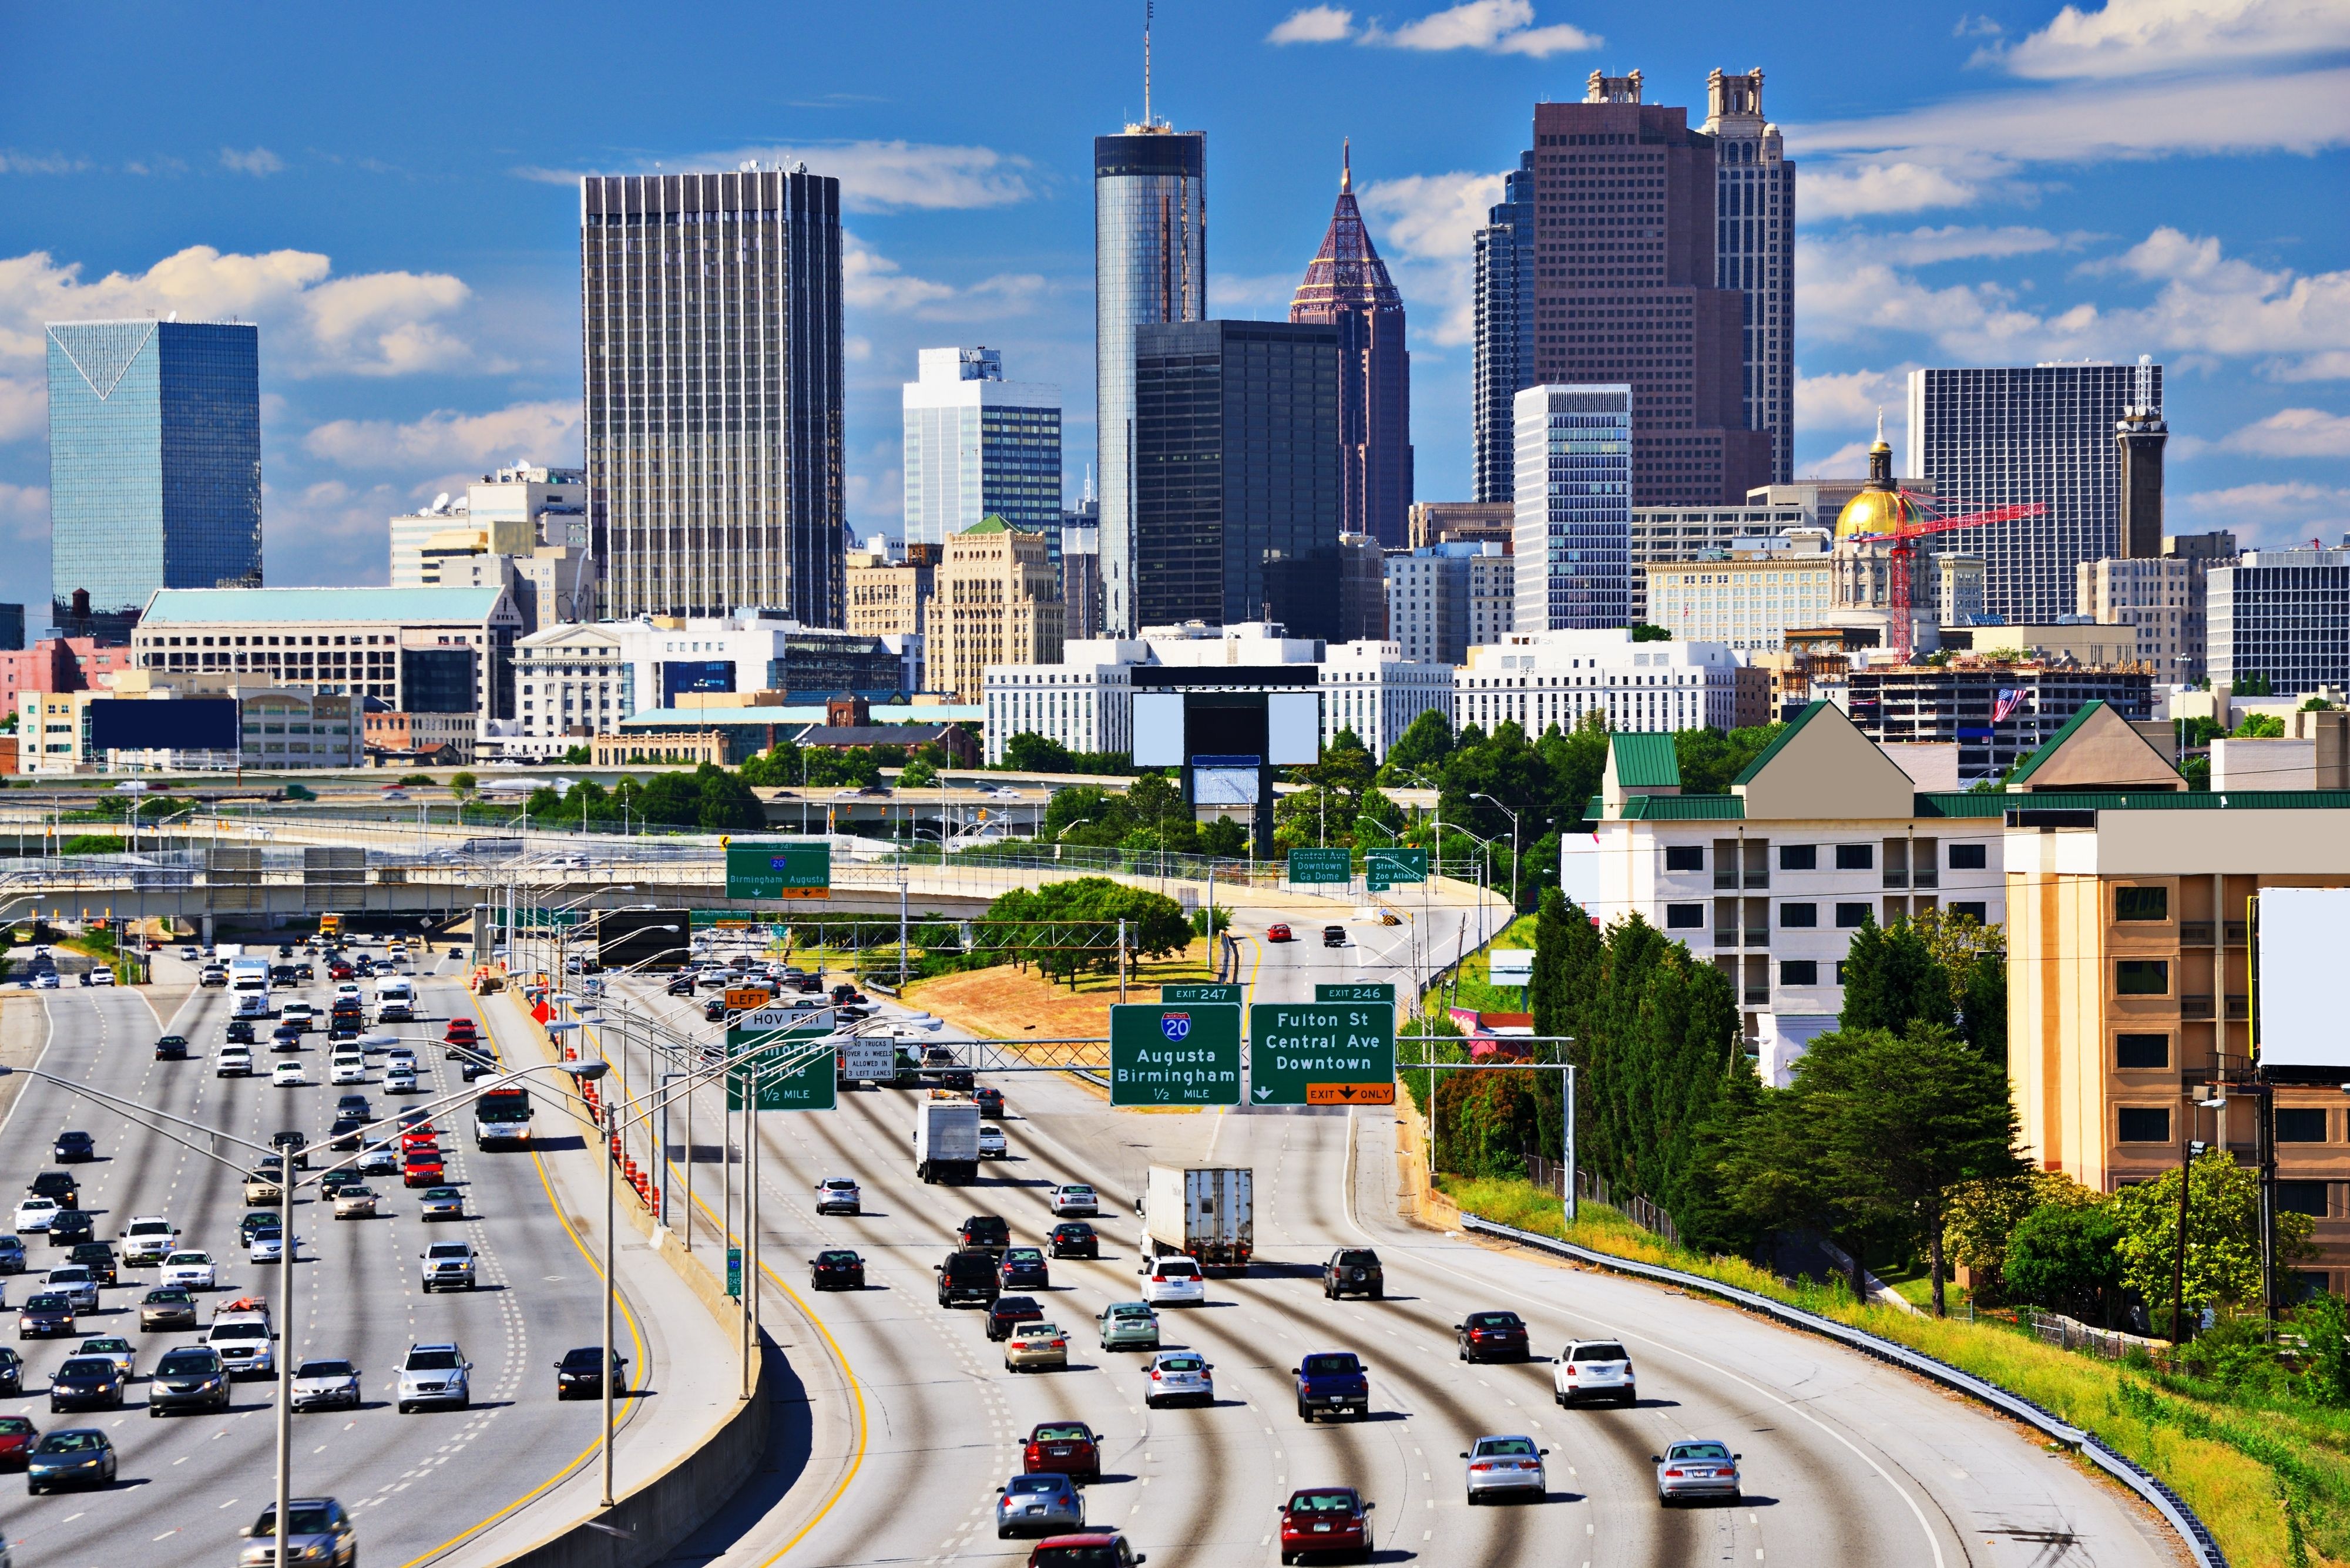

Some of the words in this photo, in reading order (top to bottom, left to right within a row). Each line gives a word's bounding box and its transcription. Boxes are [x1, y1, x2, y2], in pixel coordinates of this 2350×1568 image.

[730, 875, 783, 885] Birmingham
[790, 875, 824, 885] Augusta
[1300, 872, 1311, 880] Ga
[1315, 872, 1340, 880] Dome
[1200, 989, 1227, 999] 247
[1353, 988, 1381, 999] 246
[730, 994, 764, 1005] LEFT
[754, 1013, 783, 1025] HOV
[791, 1013, 821, 1024] EXIT
[1278, 1013, 1338, 1027] Fulton
[1349, 1012, 1368, 1026] St
[1166, 1019, 1189, 1036] 20
[1266, 1034, 1335, 1049] Central
[1347, 1034, 1379, 1048] Ave
[1137, 1049, 1216, 1066] Augusta
[1277, 1056, 1371, 1070] Downtown
[1118, 1069, 1234, 1086] Birmingham
[784, 1090, 810, 1099] MILE
[1184, 1089, 1210, 1098] MILE
[1310, 1090, 1335, 1099] EXIT
[1361, 1089, 1390, 1099] ONLY
